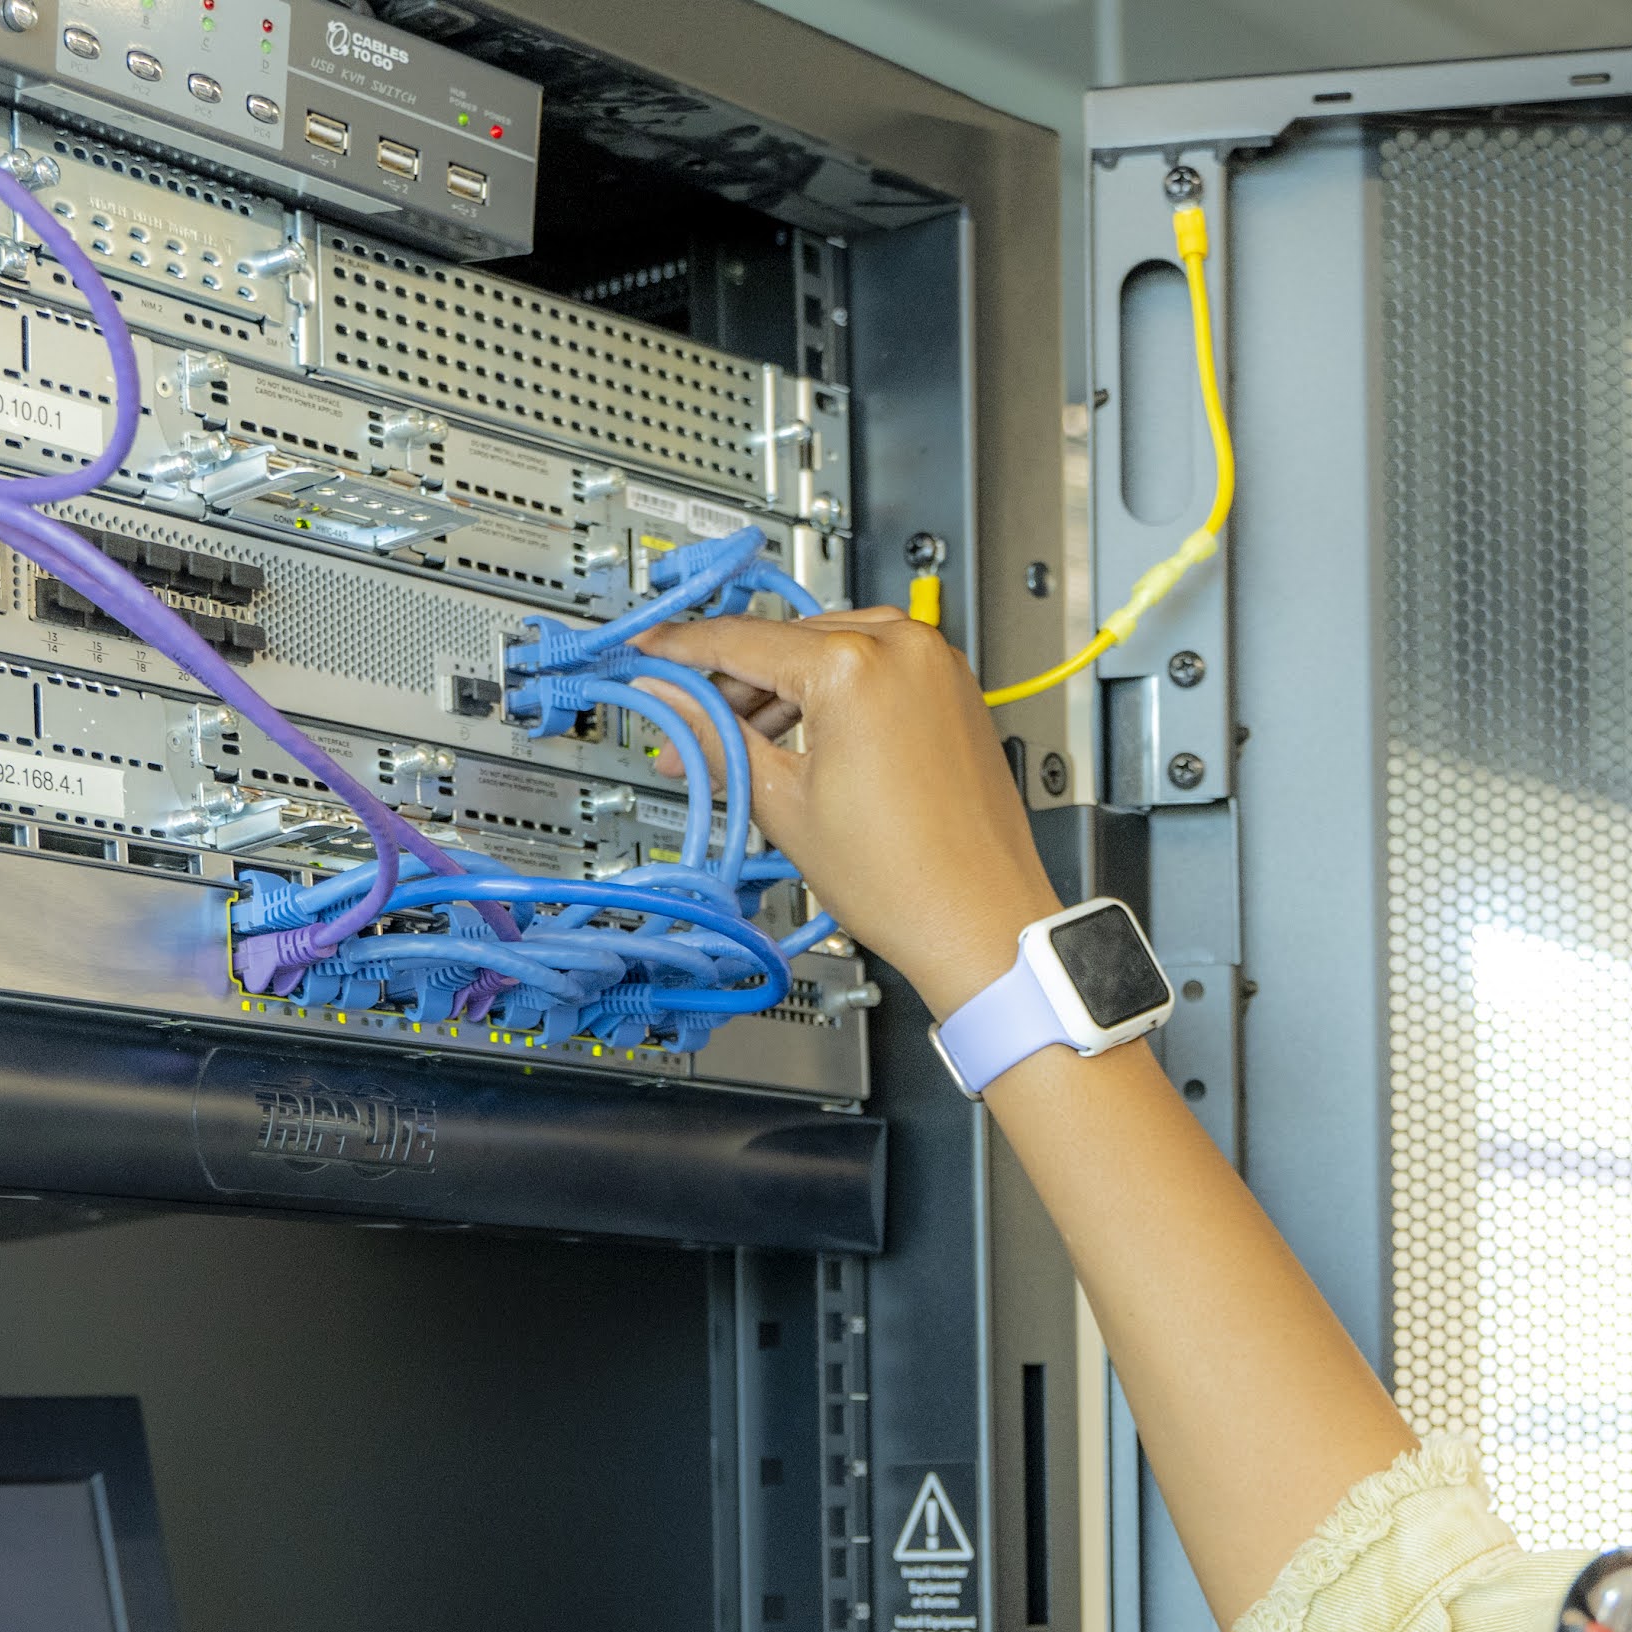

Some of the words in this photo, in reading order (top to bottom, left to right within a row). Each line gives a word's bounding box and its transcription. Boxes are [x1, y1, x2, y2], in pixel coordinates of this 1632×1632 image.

[352, 32, 409, 64] CABLES
[352, 45, 371, 63] TO
[372, 54, 394, 71] GO
[310, 57, 335, 74] USB
[340, 69, 365, 85] KVM
[370, 80, 417, 105] SWITCH
[141, 300, 156, 310] NIM
[273, 514, 294, 526] CONN
[48, 631, 58, 642] 13
[48, 644, 58, 653] 14
[92, 641, 102, 651] 15
[93, 653, 103, 664] 16
[136, 650, 146, 660] 17
[136, 662, 147, 672] 18
[178, 672, 190, 681] 20
